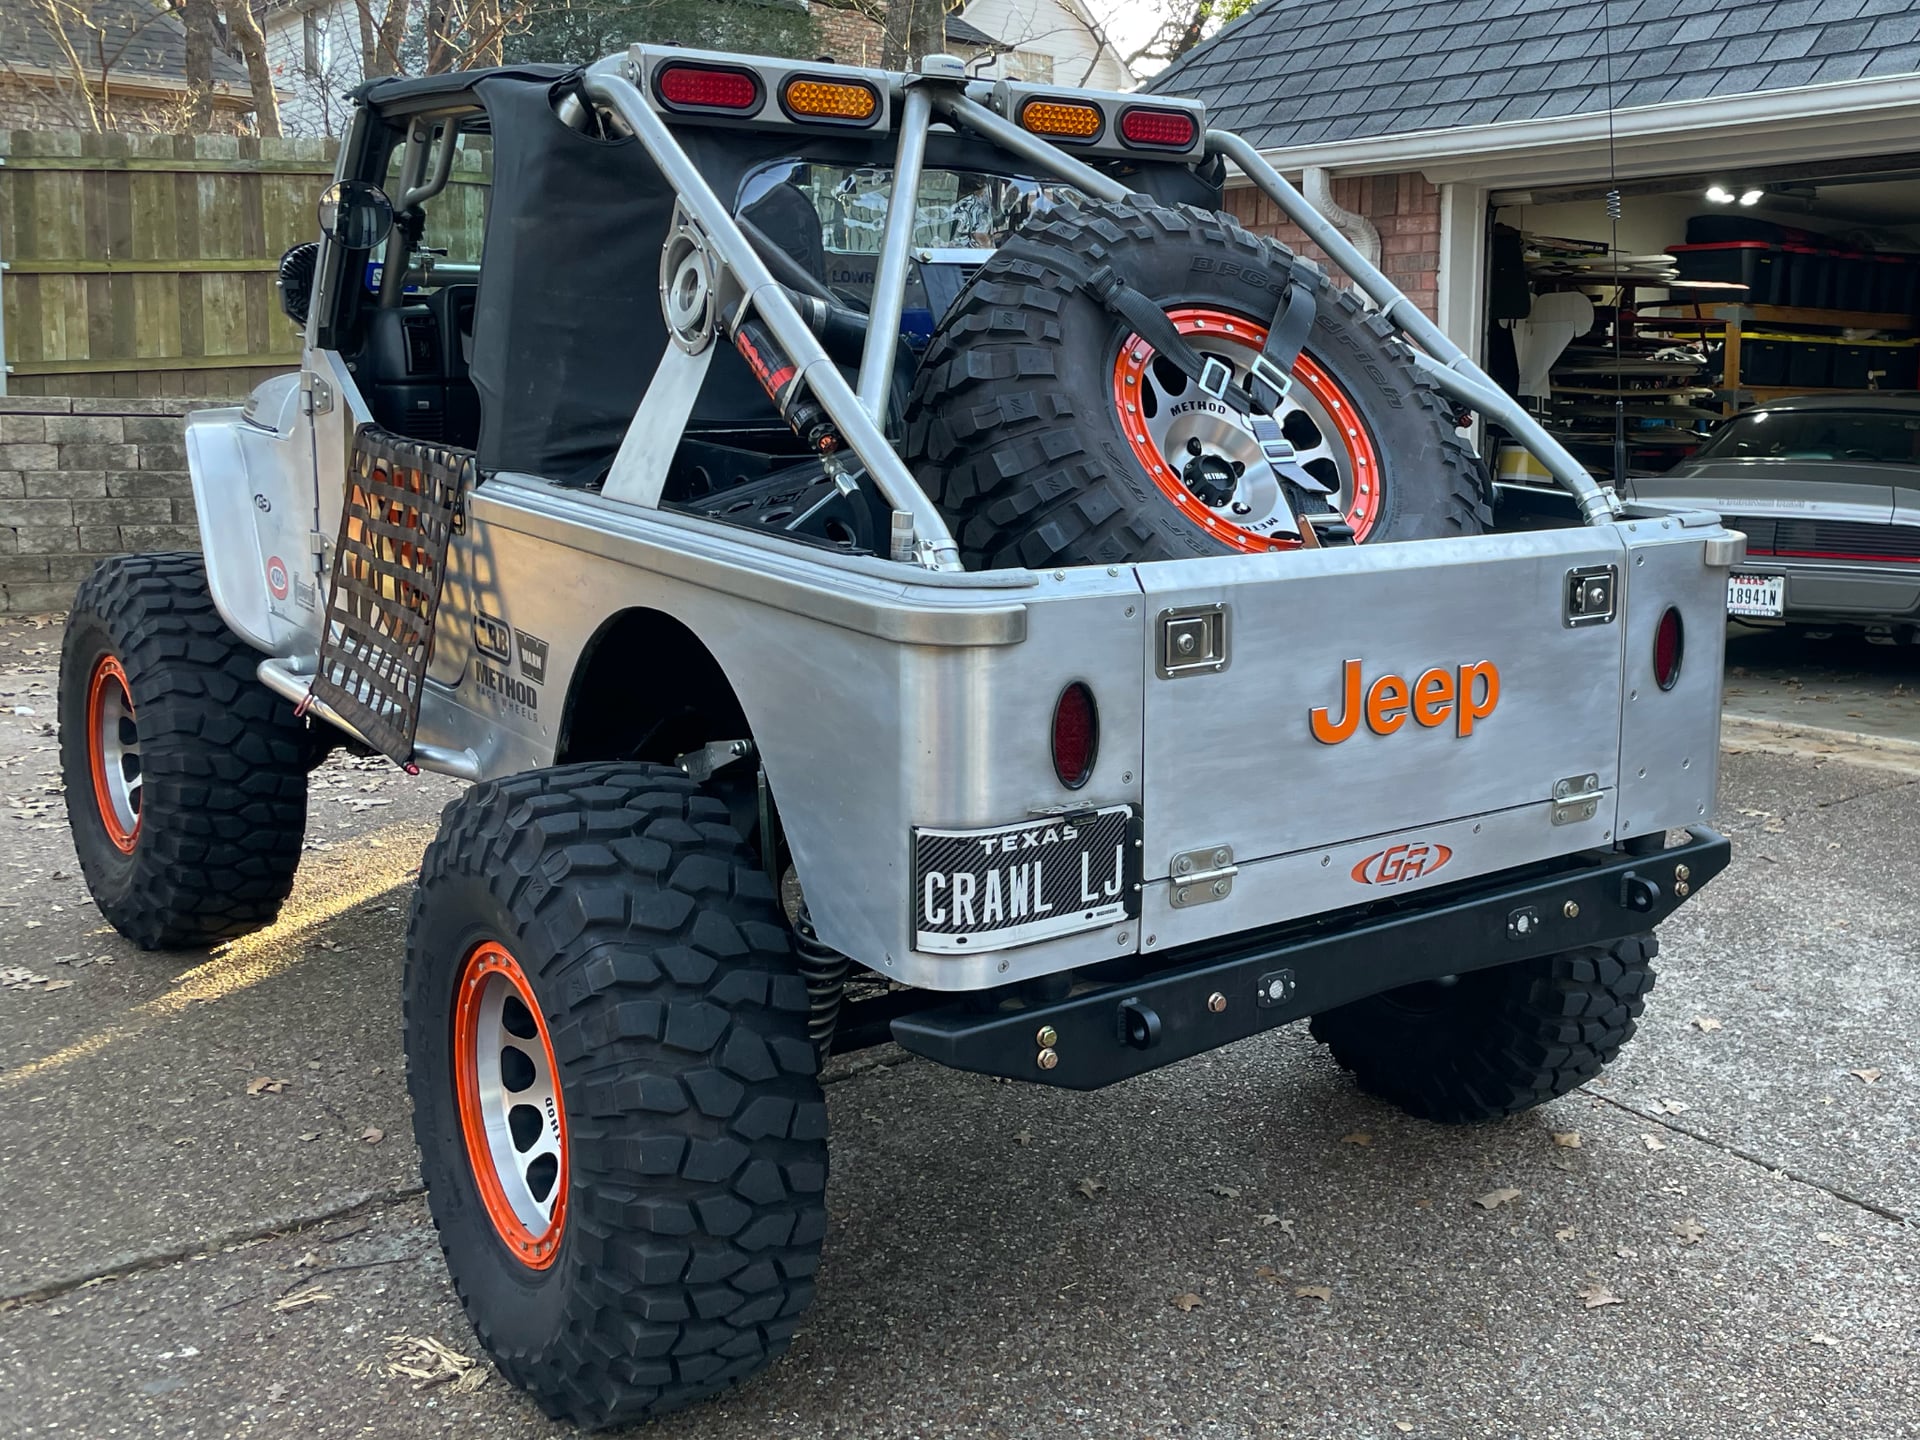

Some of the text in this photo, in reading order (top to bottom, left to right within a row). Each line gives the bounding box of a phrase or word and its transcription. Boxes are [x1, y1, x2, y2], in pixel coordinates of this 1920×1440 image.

[832, 270, 914, 286] LOWRE
[1169, 400, 1227, 417] METHOD
[1240, 517, 1279, 532] METH
[1732, 578, 1765, 586] TEXAS
[1728, 587, 1777, 606] 18941N
[476, 660, 537, 710] METHOD
[502, 698, 538, 723] WHEELS
[1309, 658, 1500, 745] Jeep
[980, 826, 1078, 855] TEXAS
[924, 844, 1124, 926] CRAWL LJ
[545, 1096, 561, 1150] THOD
